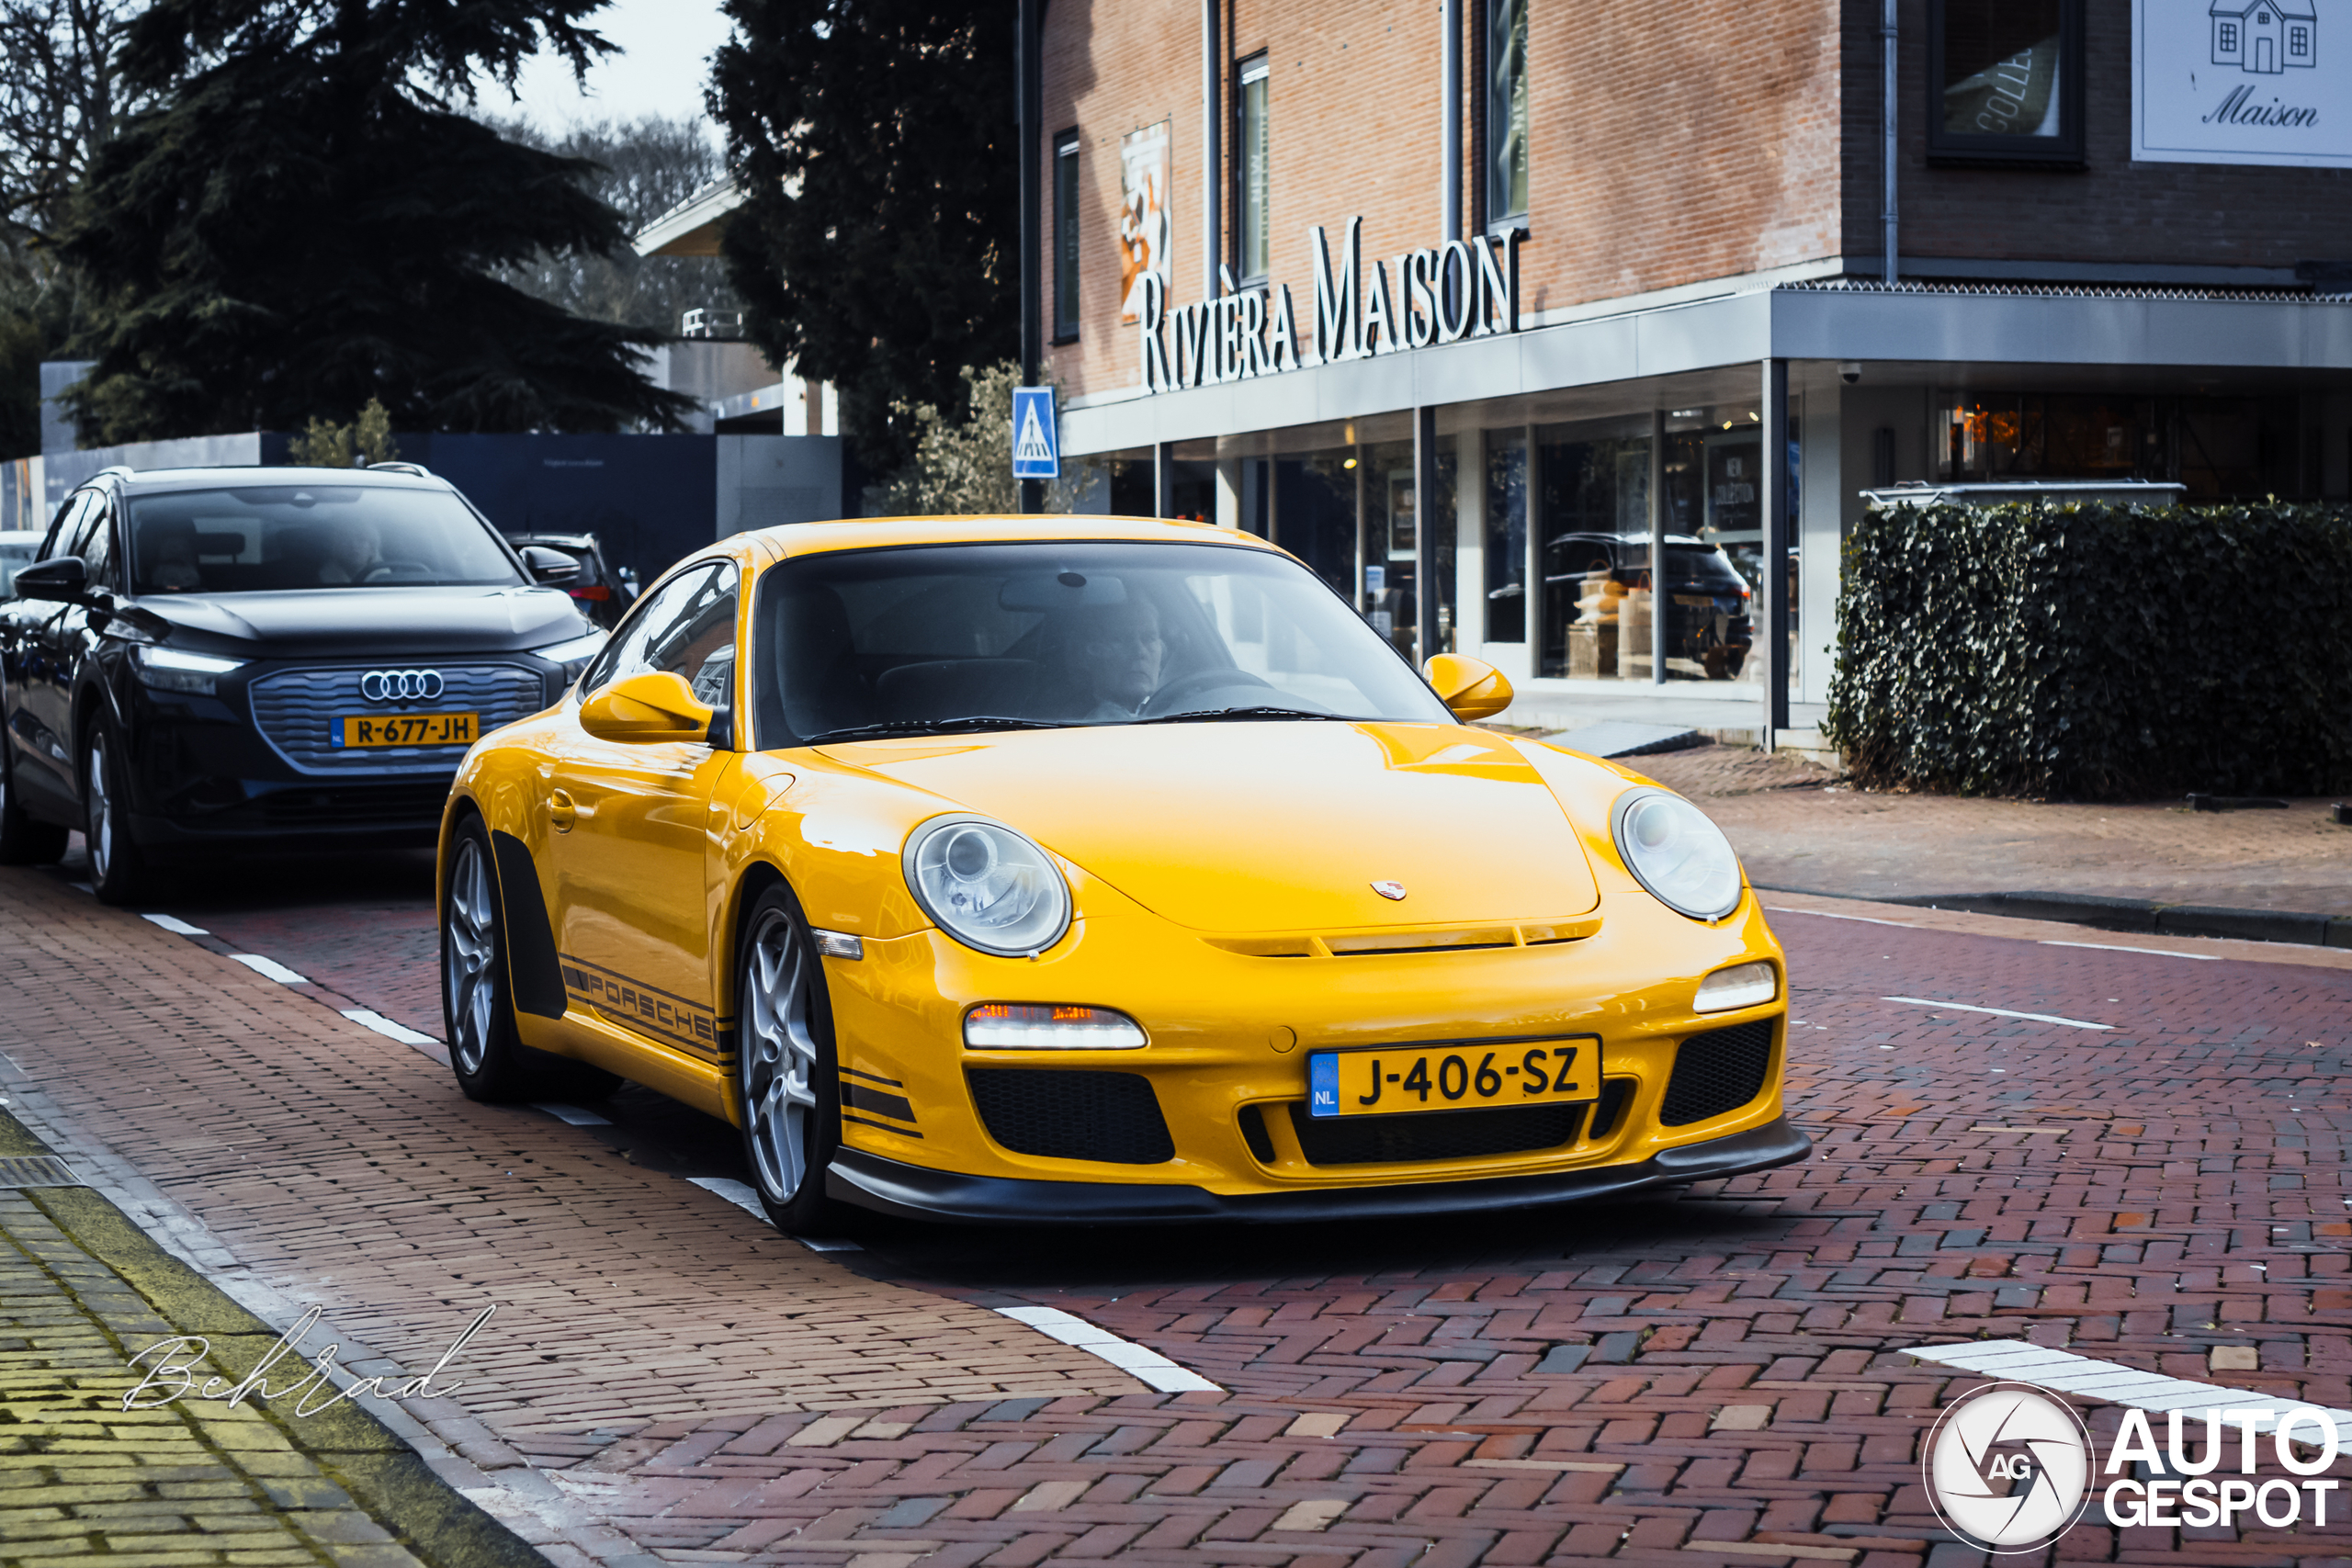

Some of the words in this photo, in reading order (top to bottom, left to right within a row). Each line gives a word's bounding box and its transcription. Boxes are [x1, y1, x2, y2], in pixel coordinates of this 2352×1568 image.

[2201, 84, 2319, 128] Maison
[1137, 263, 1302, 396] RIVIÈRA
[1308, 215, 1521, 367] MAISON
[358, 717, 469, 743] R-677-JH
[587, 973, 714, 1042] PORSCHE
[1315, 1090, 1336, 1106] NL
[1358, 1046, 1579, 1106] J-406-SZ
